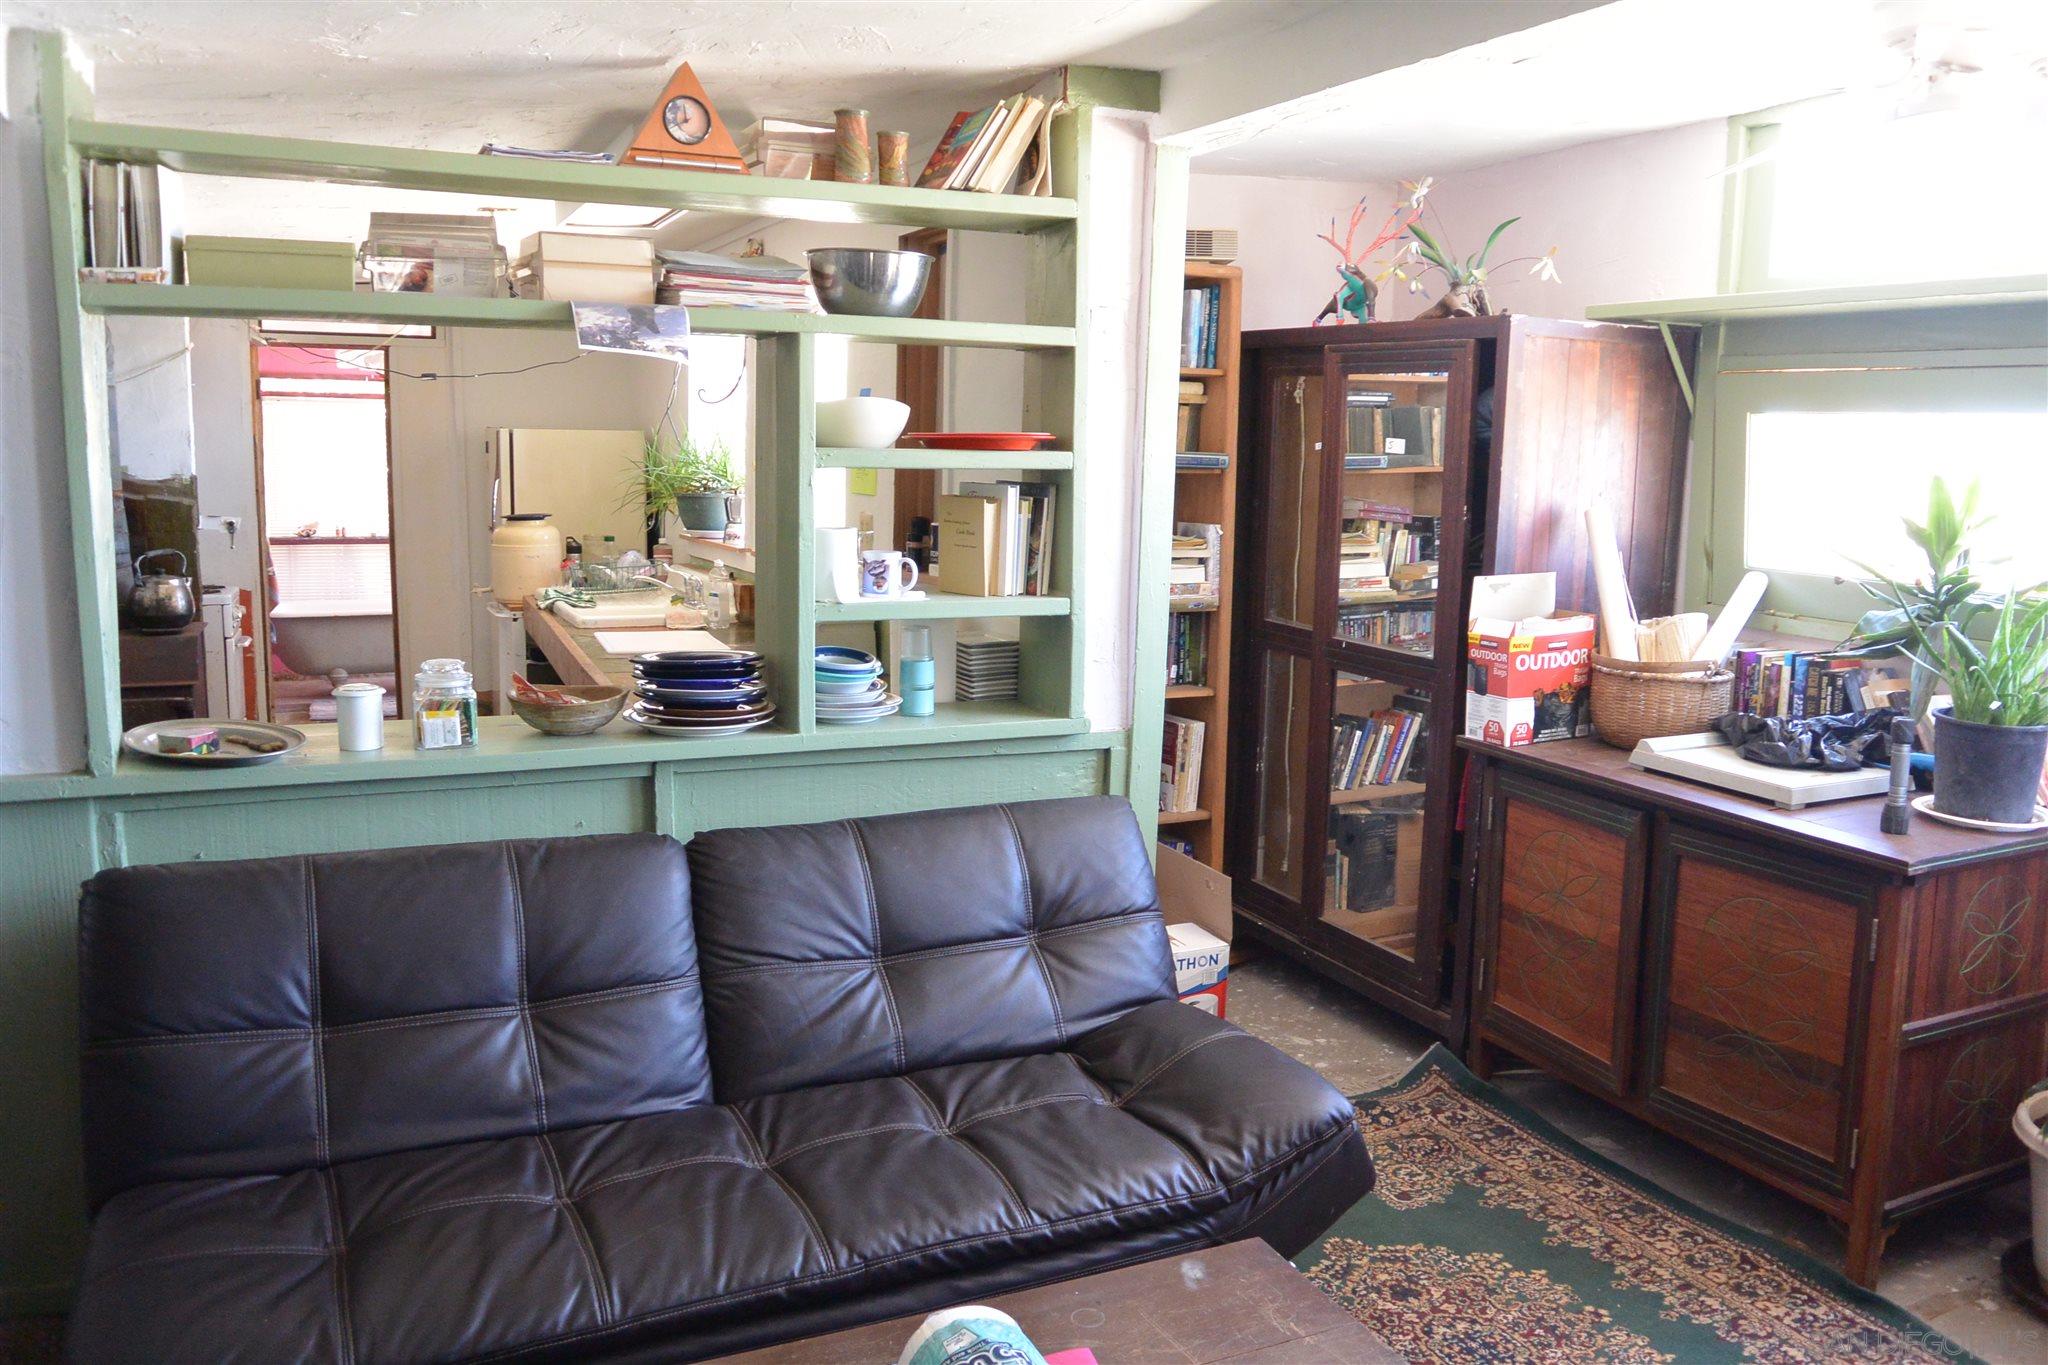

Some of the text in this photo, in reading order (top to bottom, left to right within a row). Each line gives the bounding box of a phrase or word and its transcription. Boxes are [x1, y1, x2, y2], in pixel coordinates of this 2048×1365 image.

[1470, 648, 1508, 663] OUTDOOR
[1515, 648, 1588, 672] OUTDOOR
[1493, 668, 1508, 678] Bags
[1793, 694, 1804, 716] 1222
[1488, 721, 1499, 732] 50
[1516, 724, 1528, 735] 50
[1174, 953, 1219, 972] THON
